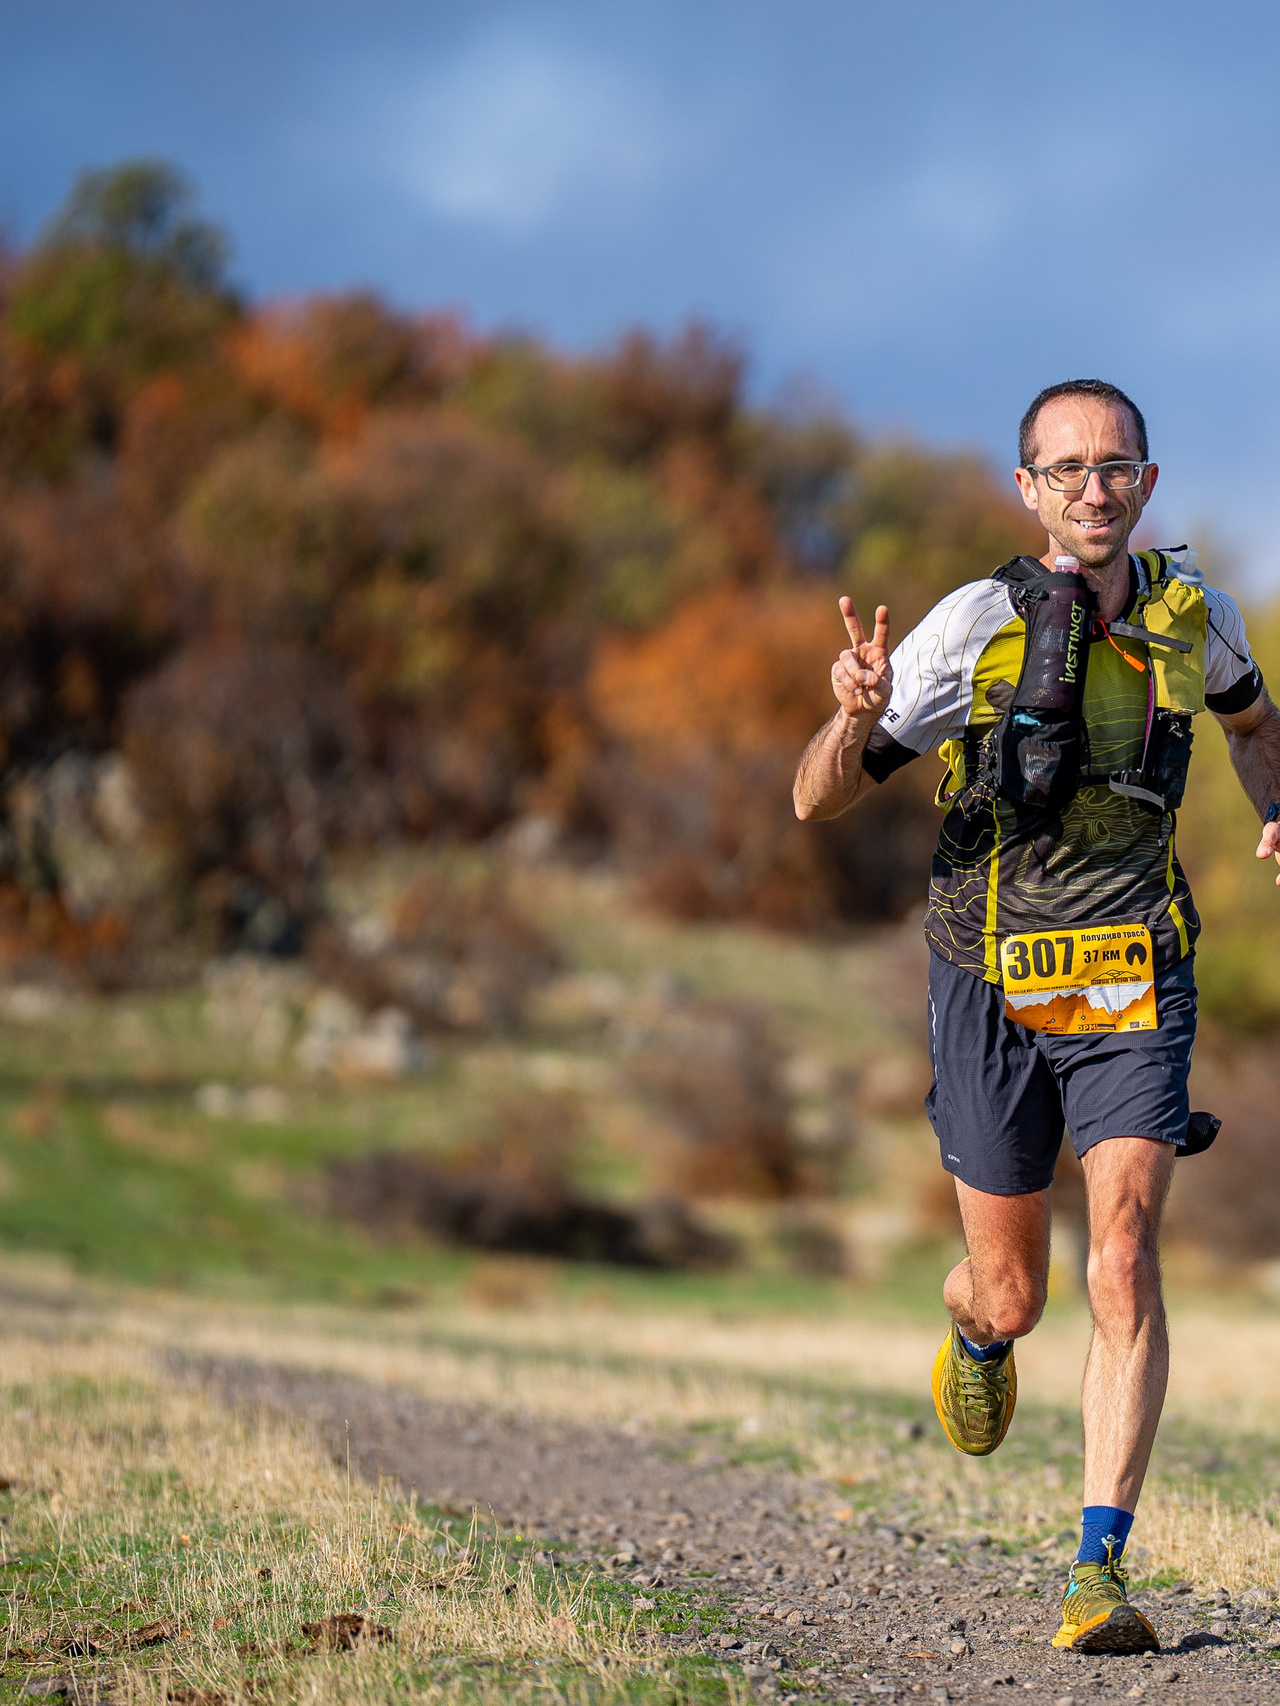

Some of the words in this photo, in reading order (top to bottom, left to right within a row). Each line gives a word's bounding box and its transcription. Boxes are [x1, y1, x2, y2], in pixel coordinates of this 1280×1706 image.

[1081, 932, 1121, 942] Полудиво
[1123, 931, 1145, 939] трасе
[1006, 937, 1074, 980] 307
[1083, 950, 1099, 964] 37
